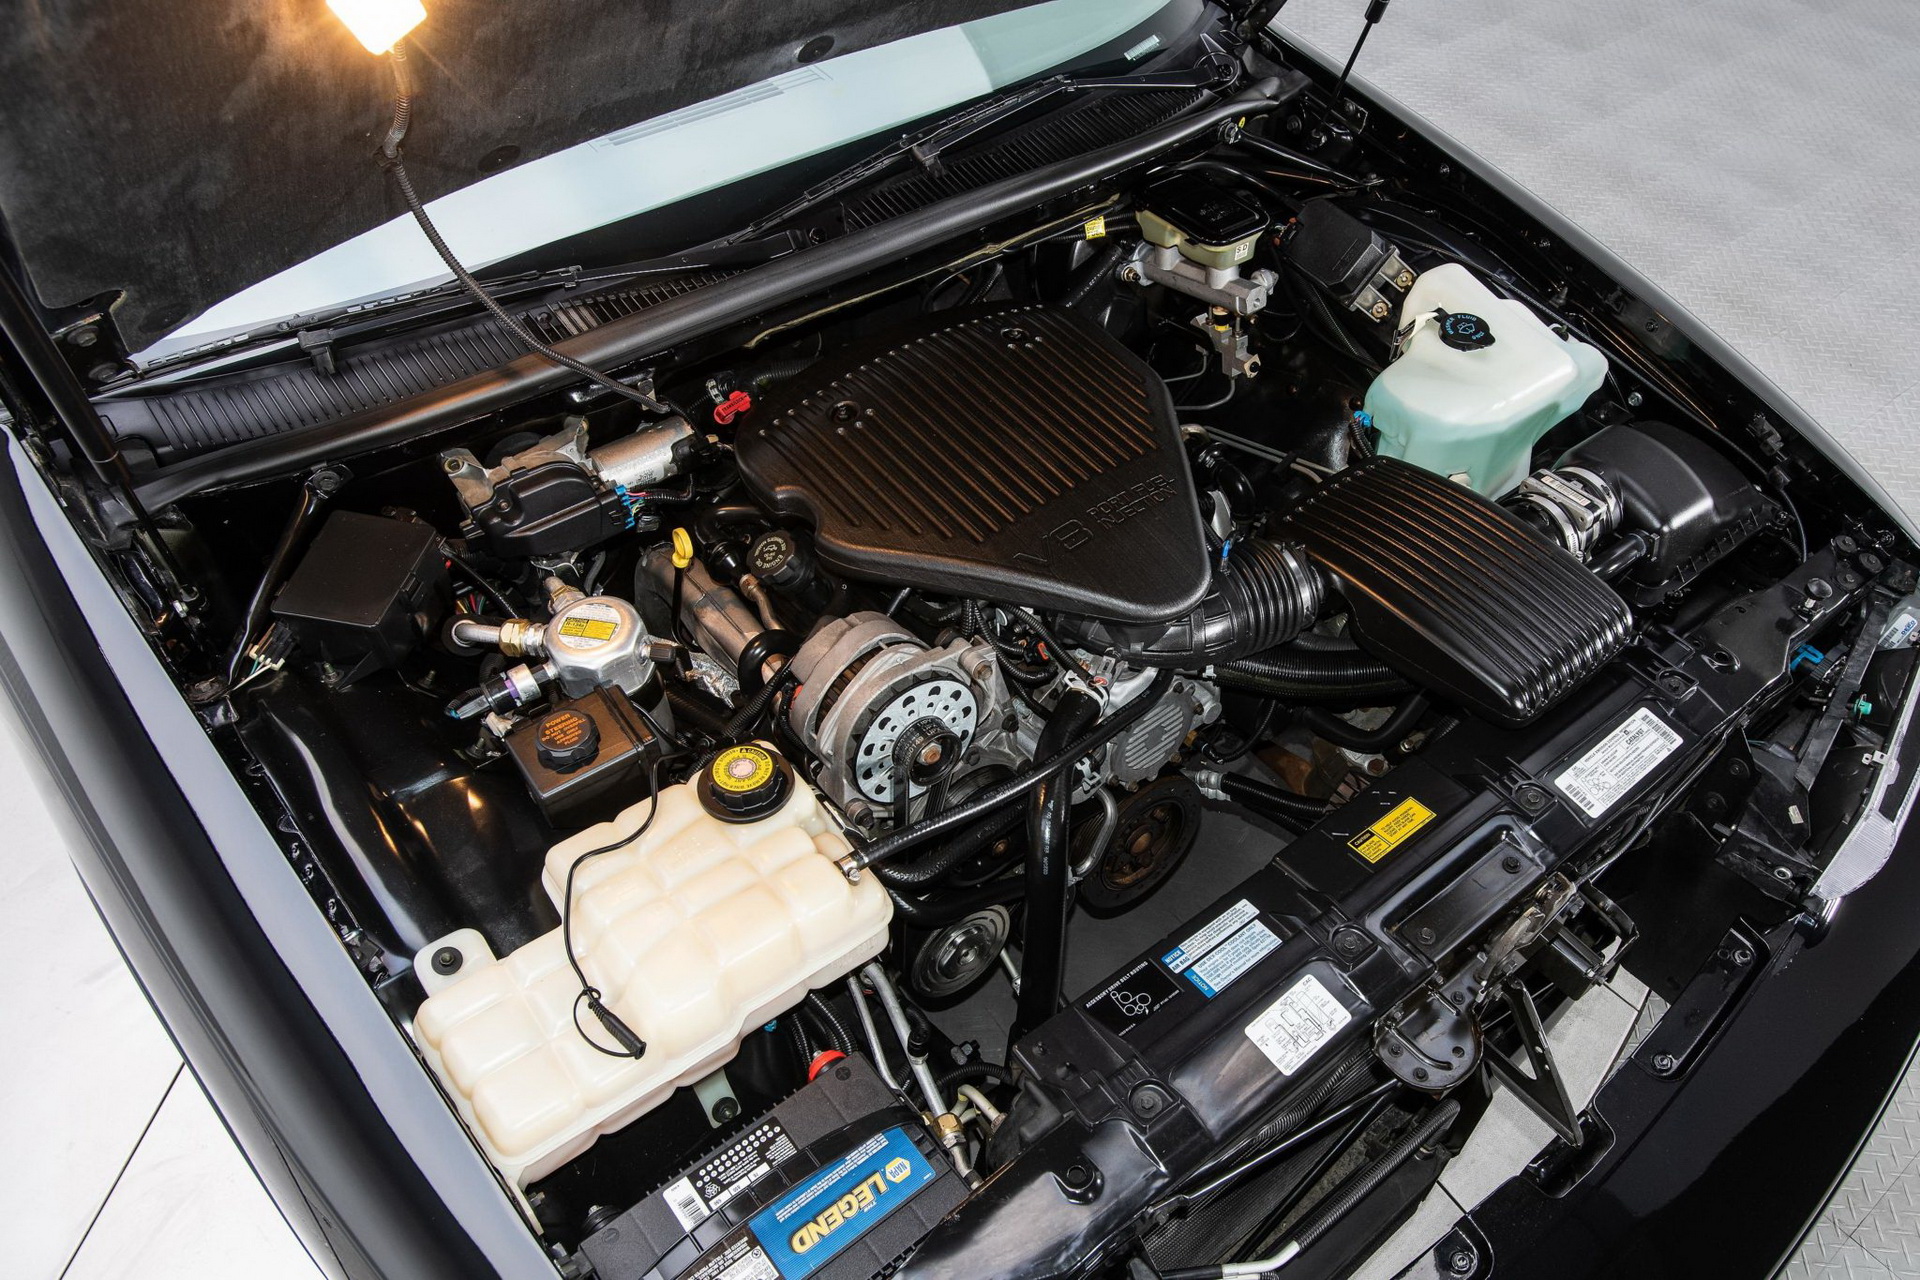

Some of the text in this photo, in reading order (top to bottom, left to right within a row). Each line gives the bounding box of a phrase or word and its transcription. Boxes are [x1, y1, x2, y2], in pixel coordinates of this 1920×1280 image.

[1457, 314, 1477, 322] FLUID
[1097, 485, 1178, 530] INJECTION
[1012, 474, 1176, 563] V8 PORT FUEL
[762, 554, 784, 569] ENGINE
[544, 716, 579, 735] STEERING
[545, 713, 571, 728] POWER
[551, 729, 562, 738] NOT
[553, 733, 565, 741] USE
[1624, 727, 1646, 745] CATALYST
[747, 748, 768, 760] CAUTION
[1353, 831, 1371, 846] CAUTION
[1196, 959, 1207, 968] USE
[1225, 930, 1247, 946] COOLANT
[1244, 922, 1257, 933] ONLY
[1163, 949, 1183, 964] NOTICE
[1170, 955, 1191, 971] AIR BAG
[1084, 960, 1148, 1008] ACCESSORY DRIVE BELT ROUTING
[1189, 973, 1211, 991] NOTICE
[887, 1159, 908, 1180] NAPA
[789, 1172, 888, 1254] LEGEND
